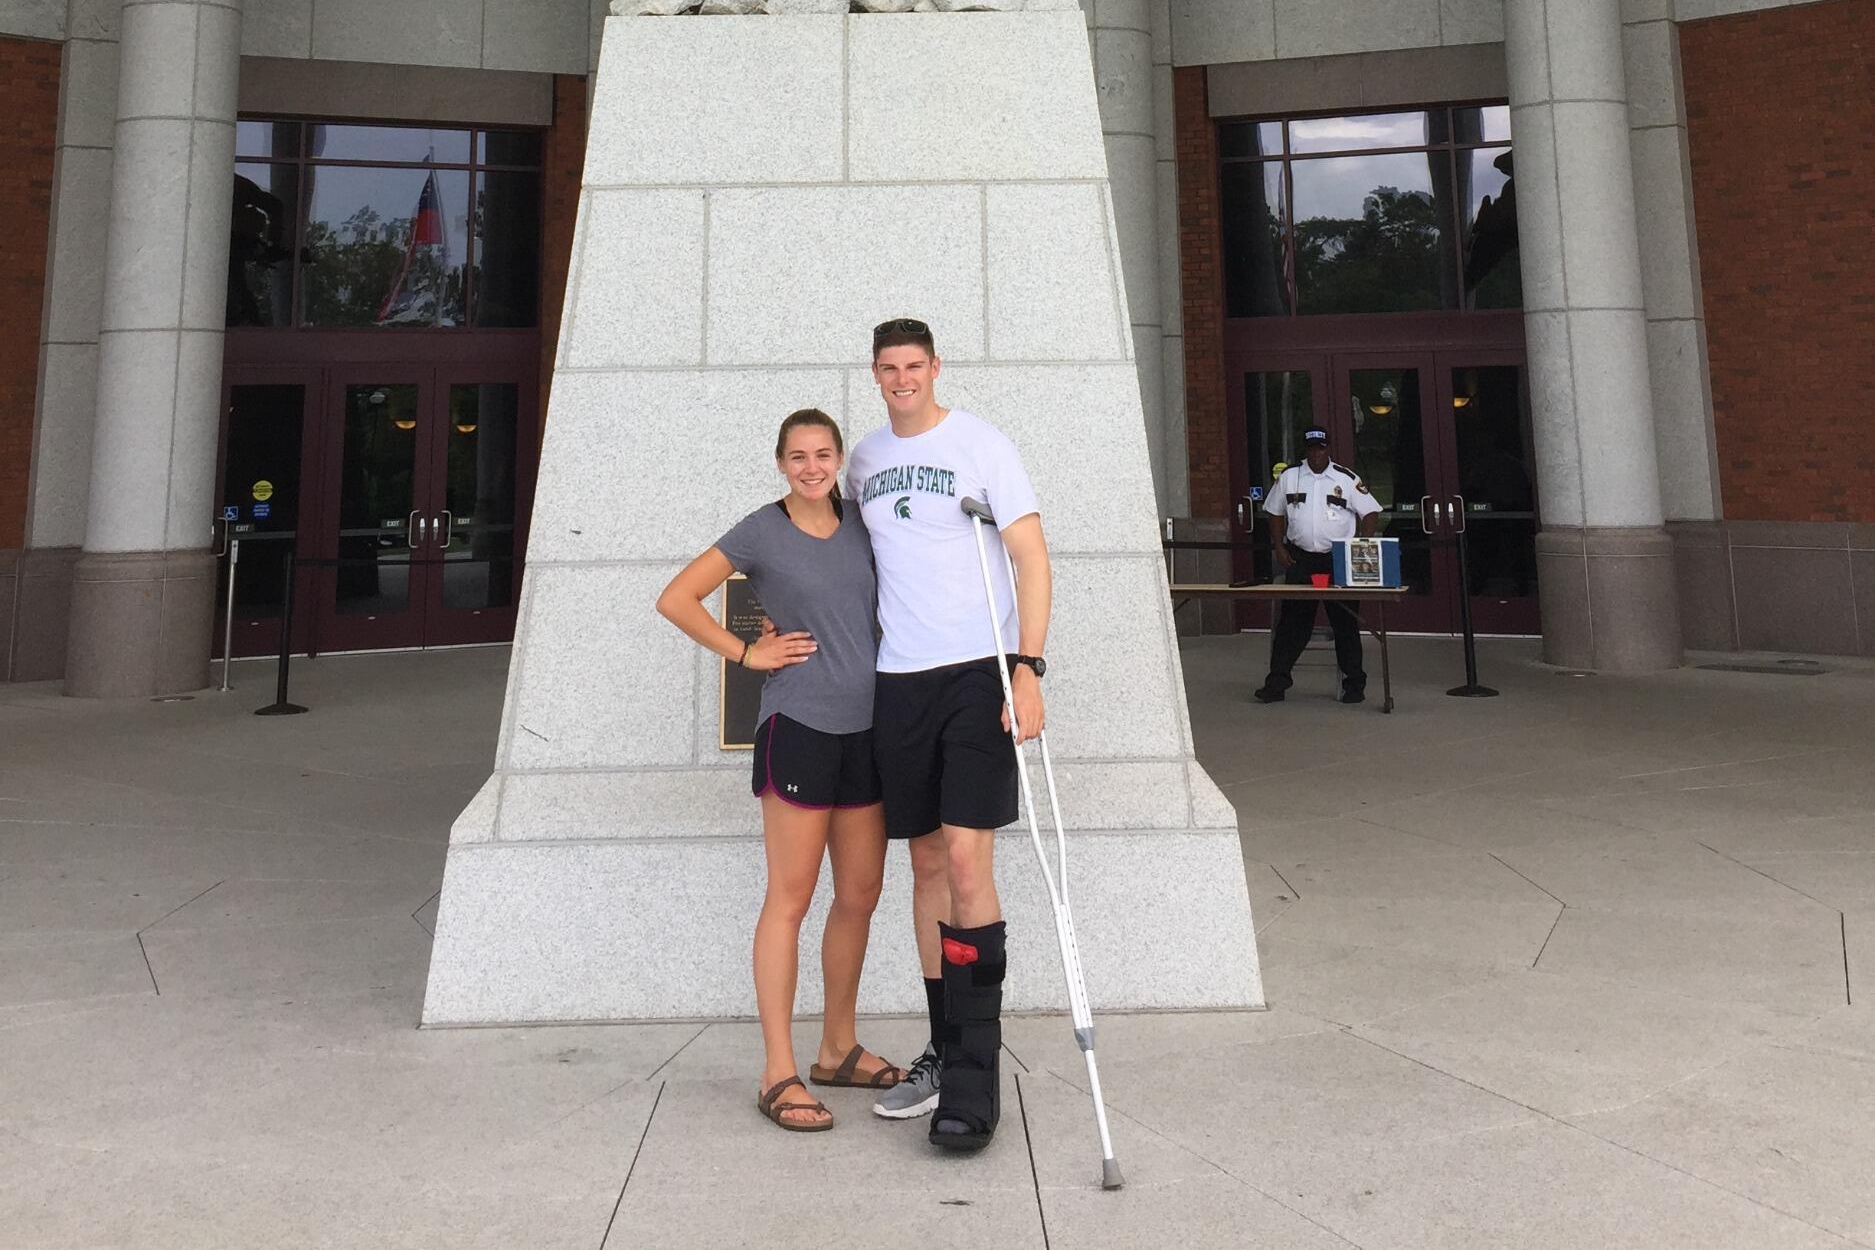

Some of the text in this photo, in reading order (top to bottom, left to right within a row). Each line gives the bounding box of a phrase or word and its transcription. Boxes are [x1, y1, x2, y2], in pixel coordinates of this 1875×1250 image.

[1305, 431, 1326, 440] SECURITY
[862, 464, 955, 505] MICHIGAN STATE
